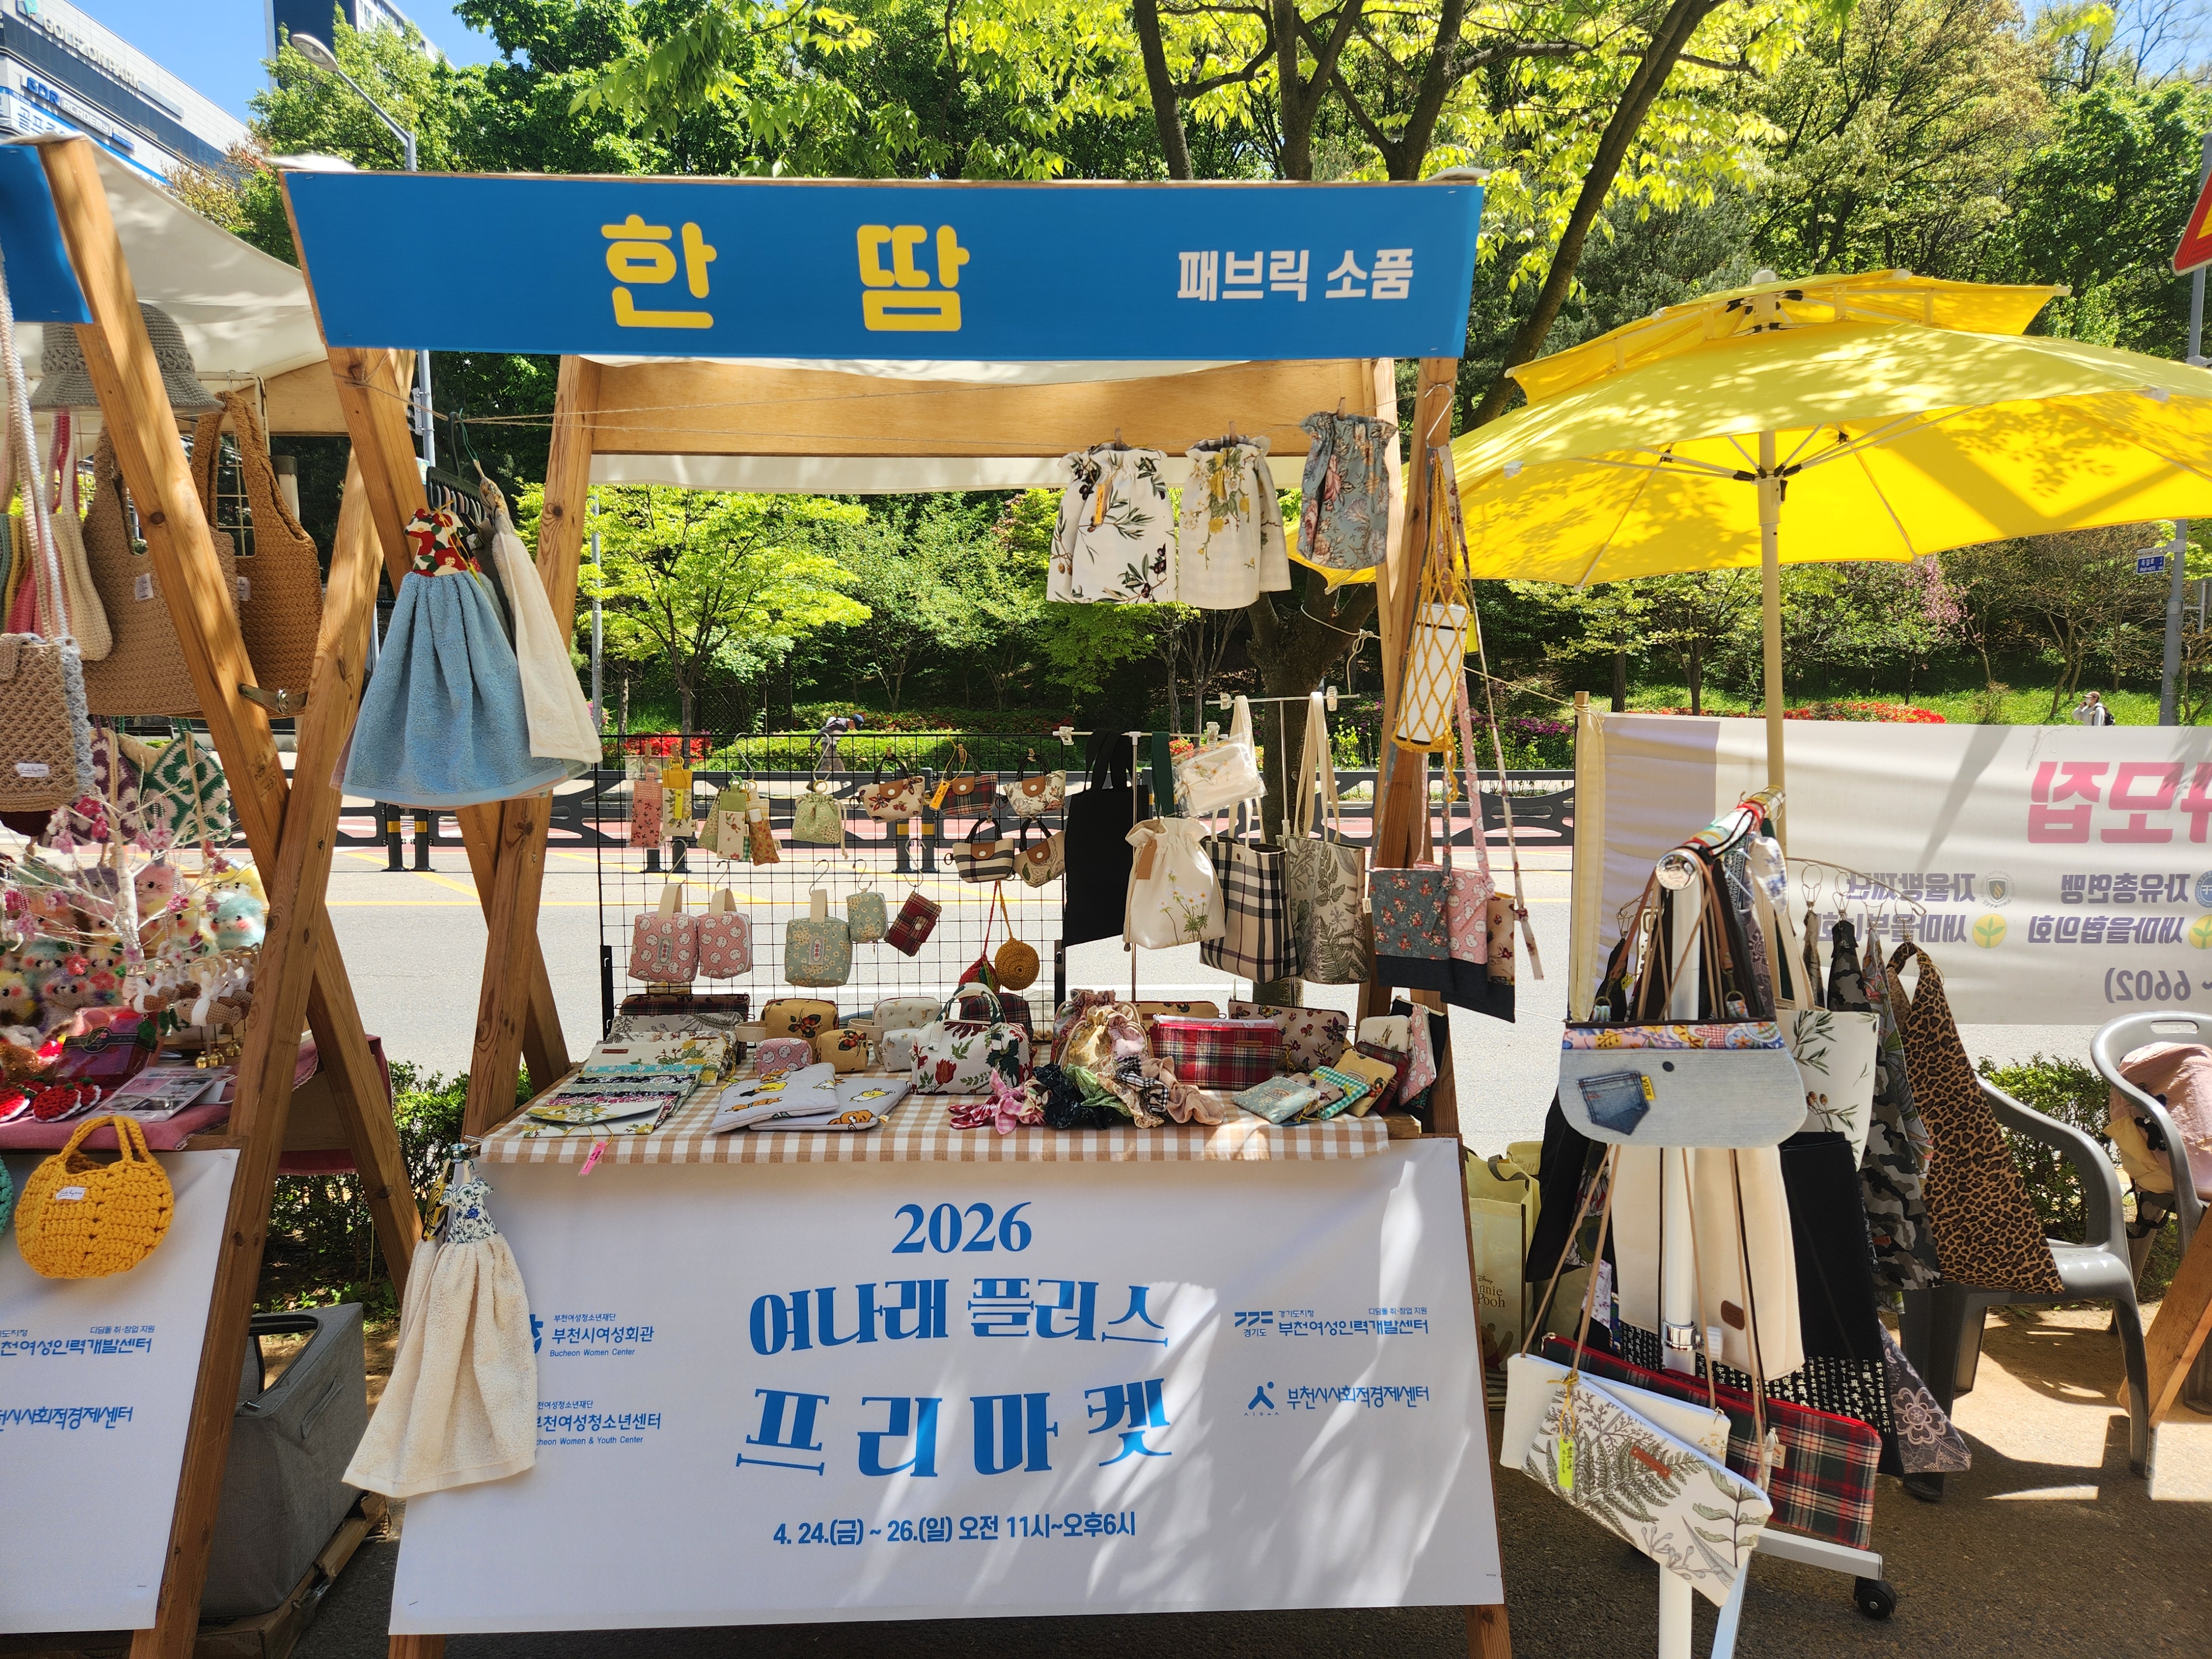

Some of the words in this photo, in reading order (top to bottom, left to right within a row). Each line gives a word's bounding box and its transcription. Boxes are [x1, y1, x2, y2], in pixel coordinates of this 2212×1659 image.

[27, 76, 61, 107] GDR
[64, 100, 110, 133] ACADEMY
[602, 215, 717, 328] 한
[857, 225, 970, 332] 땀
[1177, 249, 1309, 302] 패브릭
[1326, 248, 1413, 300] 소품
[891, 1202, 1032, 1254] 2026
[1476, 1284, 1503, 1296] innie
[1478, 1293, 1505, 1307] Pooh
[554, 1313, 616, 1323] 부천여성청소년재단
[749, 1278, 950, 1356] 여나래
[967, 1277, 1168, 1348] 플러스
[1279, 1310, 1314, 1318] 경기도지정
[1414, 1306, 1427, 1314] 지원
[140, 1325, 155, 1333] 지원
[551, 1326, 654, 1344] 부천시여성회관
[1244, 1329, 1267, 1337] 경기도
[1279, 1319, 1428, 1337] 부천여성인력개발센터
[1, 1338, 152, 1356] 천여성인력개발센터
[537, 1400, 594, 1410] 천여성청소년재단
[1287, 1385, 1429, 1410] 부천시사회적경제센터
[735, 1378, 1172, 1478] 프리마켓
[588, 1436, 594, 1444] &
[619, 1435, 643, 1444] Center
[773, 1522, 792, 1545] 4.
[797, 1517, 864, 1547] 24.(금)
[886, 1516, 953, 1543] 26.(일)
[958, 1515, 999, 1541] 오전
[1006, 1511, 1136, 1538] 11시~오후6시
